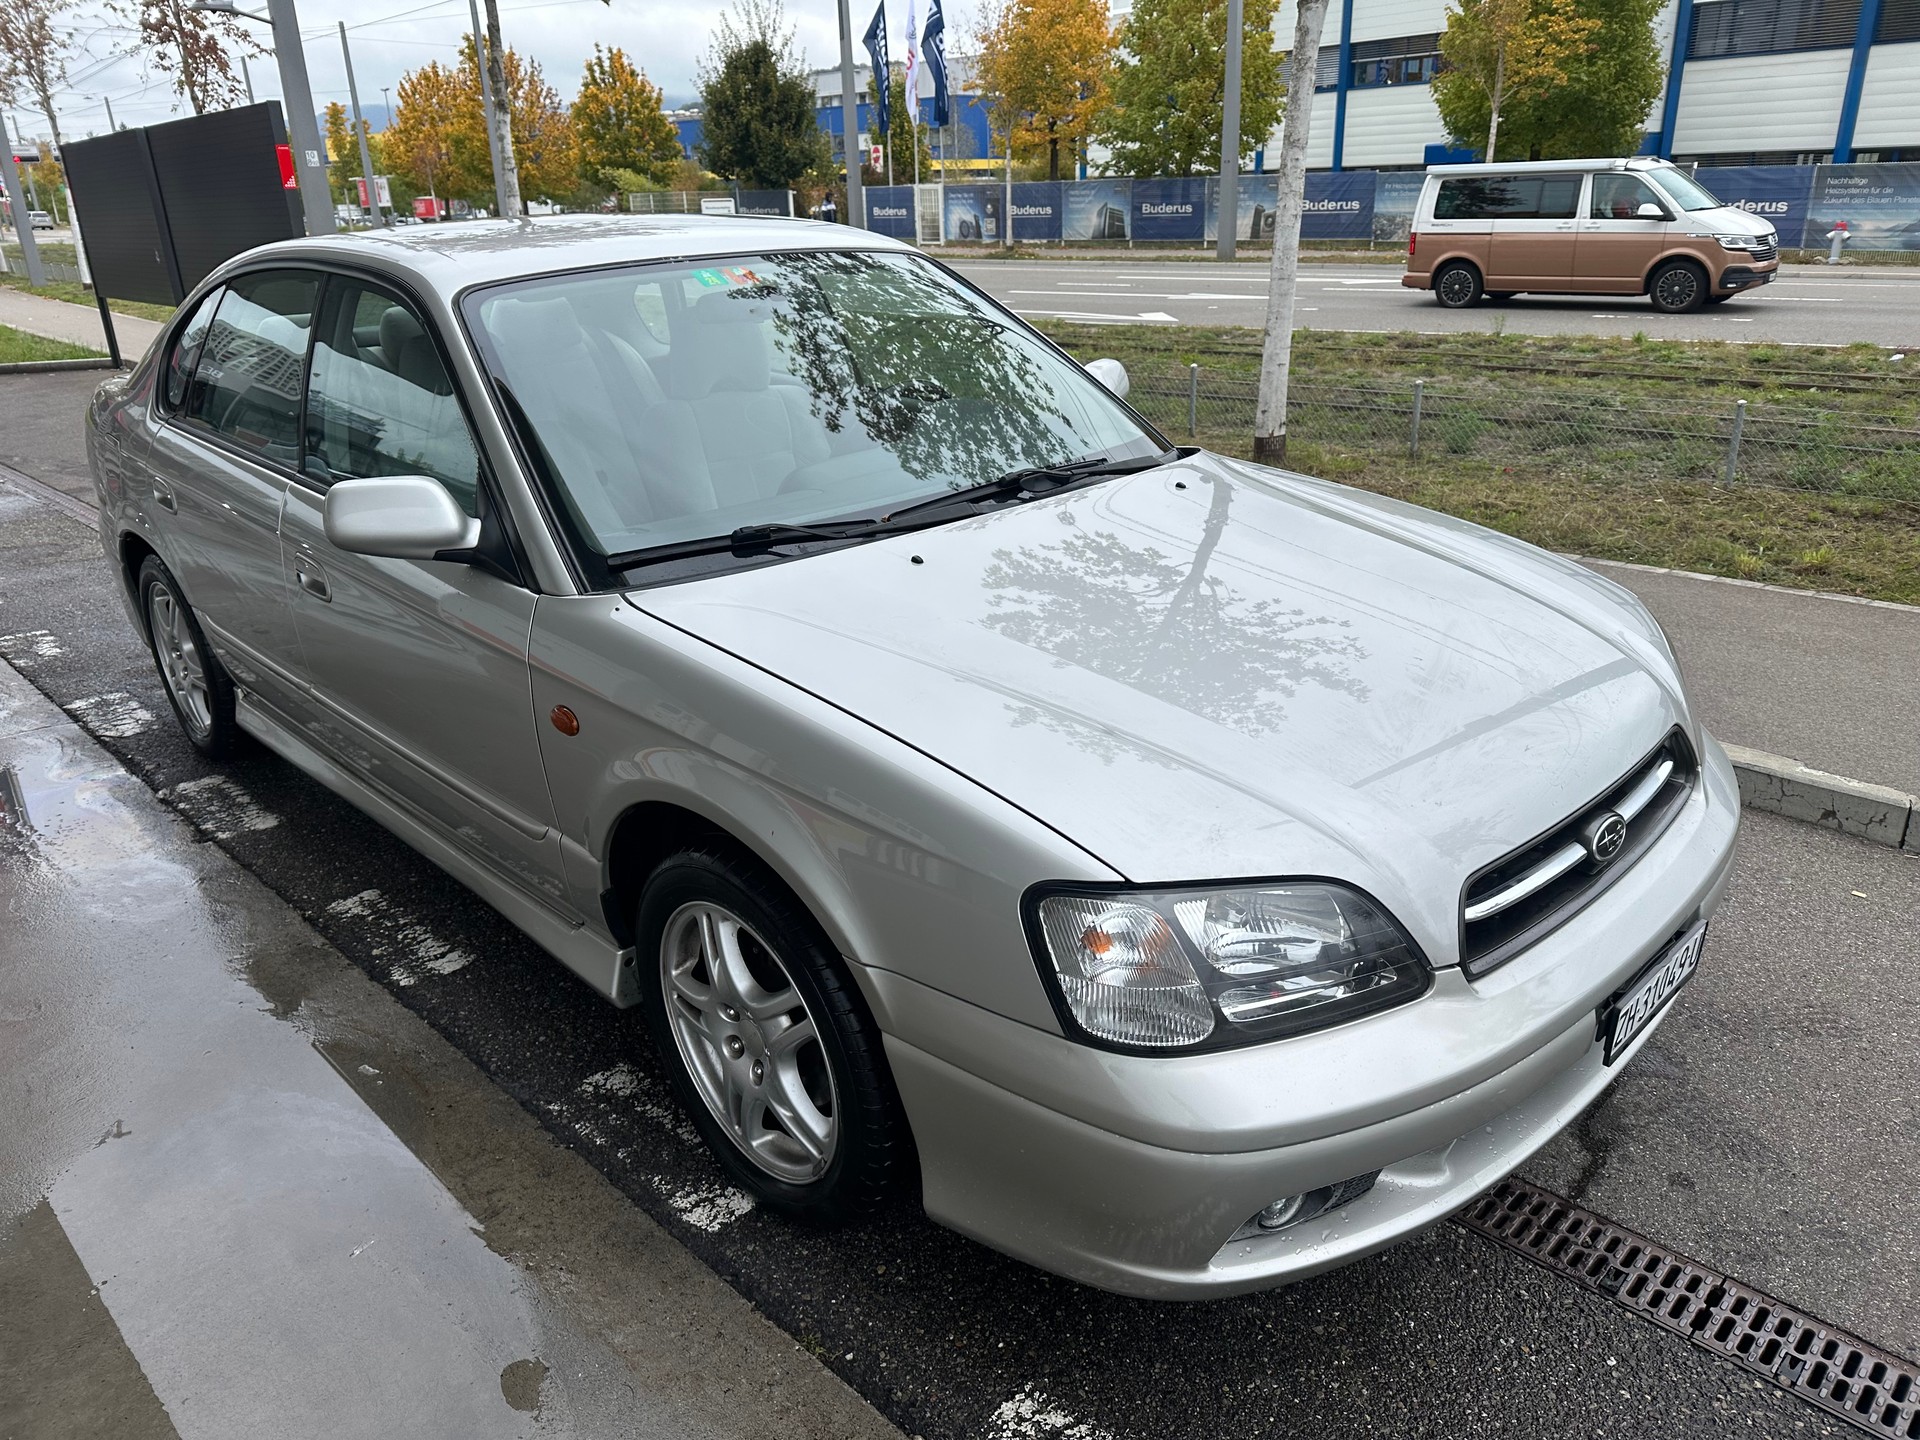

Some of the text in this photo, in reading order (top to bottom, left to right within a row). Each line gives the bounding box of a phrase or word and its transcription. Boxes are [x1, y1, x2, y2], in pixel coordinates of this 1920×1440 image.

[1827, 177, 1869, 185] Nachhaltige
[1825, 186, 1894, 195] Heizsysteme für die
[1302, 199, 1360, 211] Buderus
[1823, 196, 1850, 204] Zukunft
[1851, 196, 1865, 204] des
[1867, 196, 1892, 204] Blauen
[739, 206, 780, 214] Buderus
[873, 206, 908, 216] Buderus
[1010, 204, 1052, 215] Buderus
[1142, 203, 1192, 214] Buderus
[1837, 1334, 1861, 1349] ACO
[1870, 1349, 1899, 1367] S100
